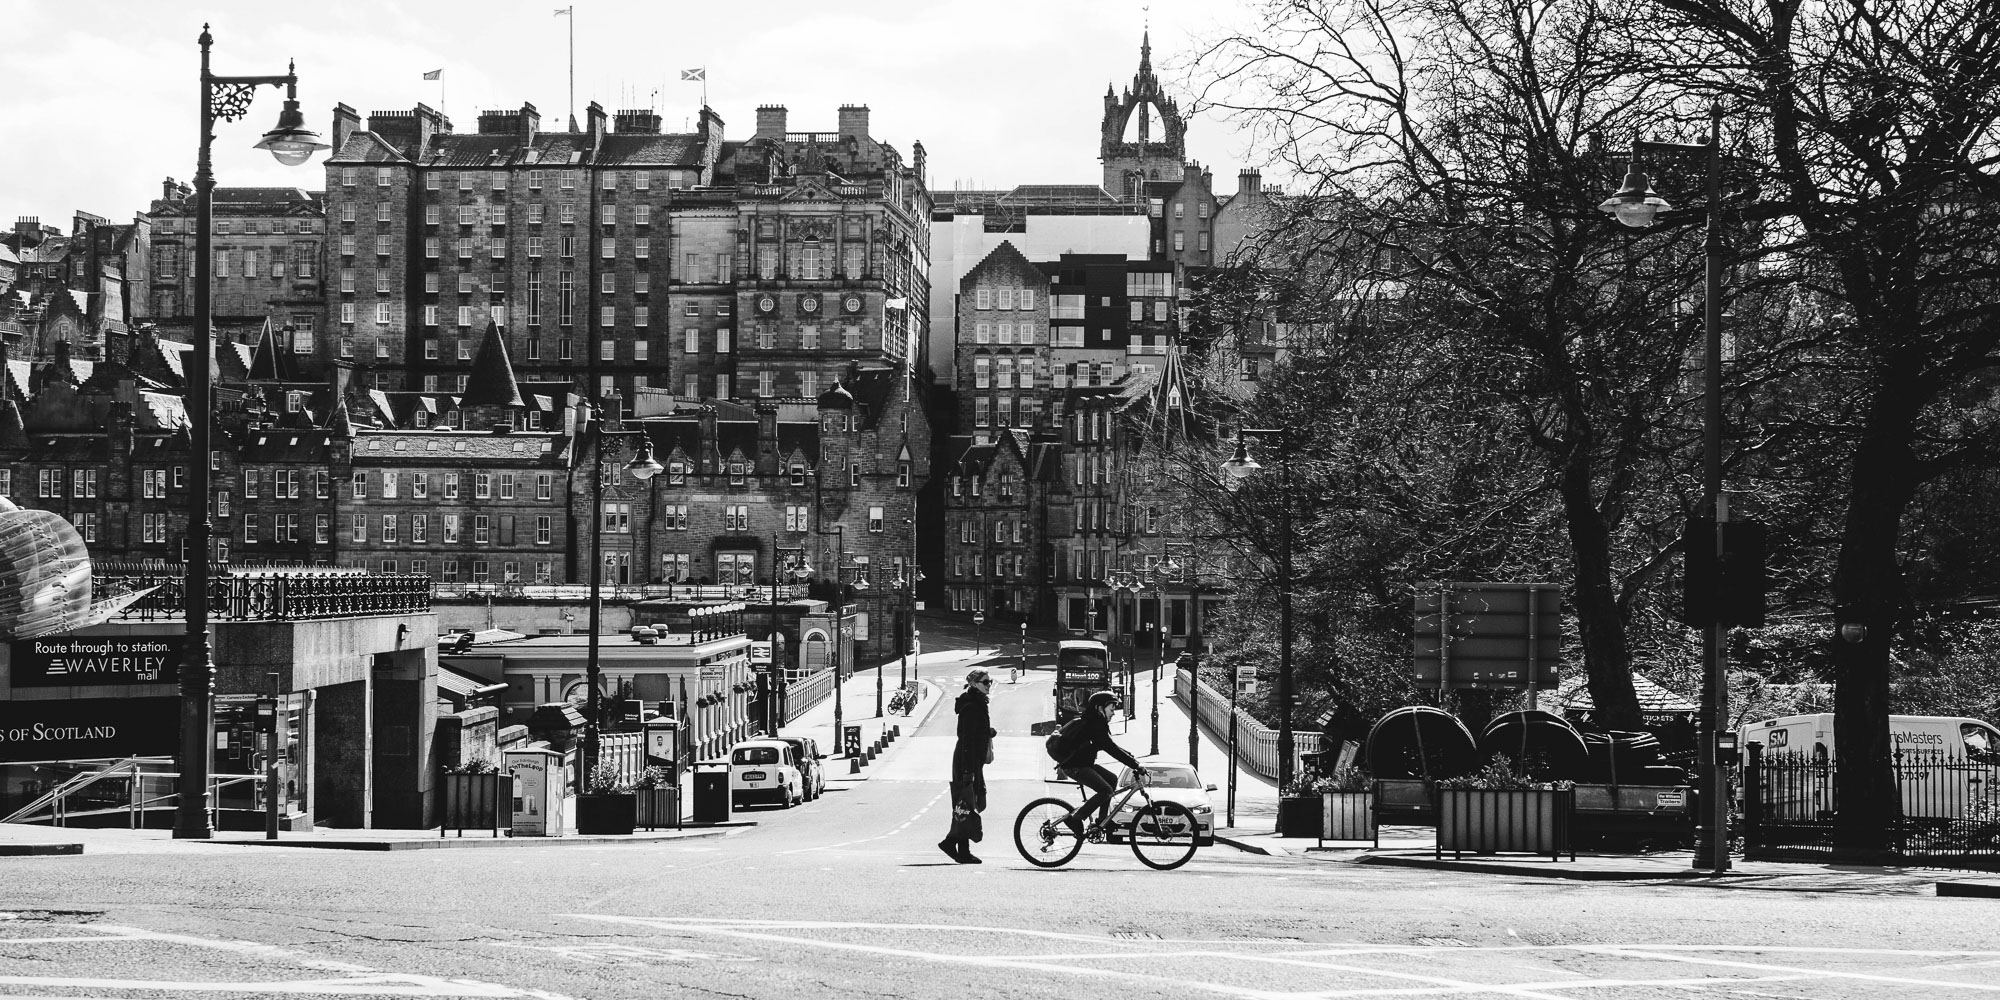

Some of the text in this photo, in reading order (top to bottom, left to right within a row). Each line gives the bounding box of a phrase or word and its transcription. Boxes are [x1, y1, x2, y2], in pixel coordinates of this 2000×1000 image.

[35, 640, 171, 656] Route through to station.
[65, 656, 165, 673] WAVERLEY
[137, 668, 158, 681] mall
[9, 728, 30, 742] OF
[32, 722, 116, 741] SCOTLAND
[1770, 731, 1786, 746] SM
